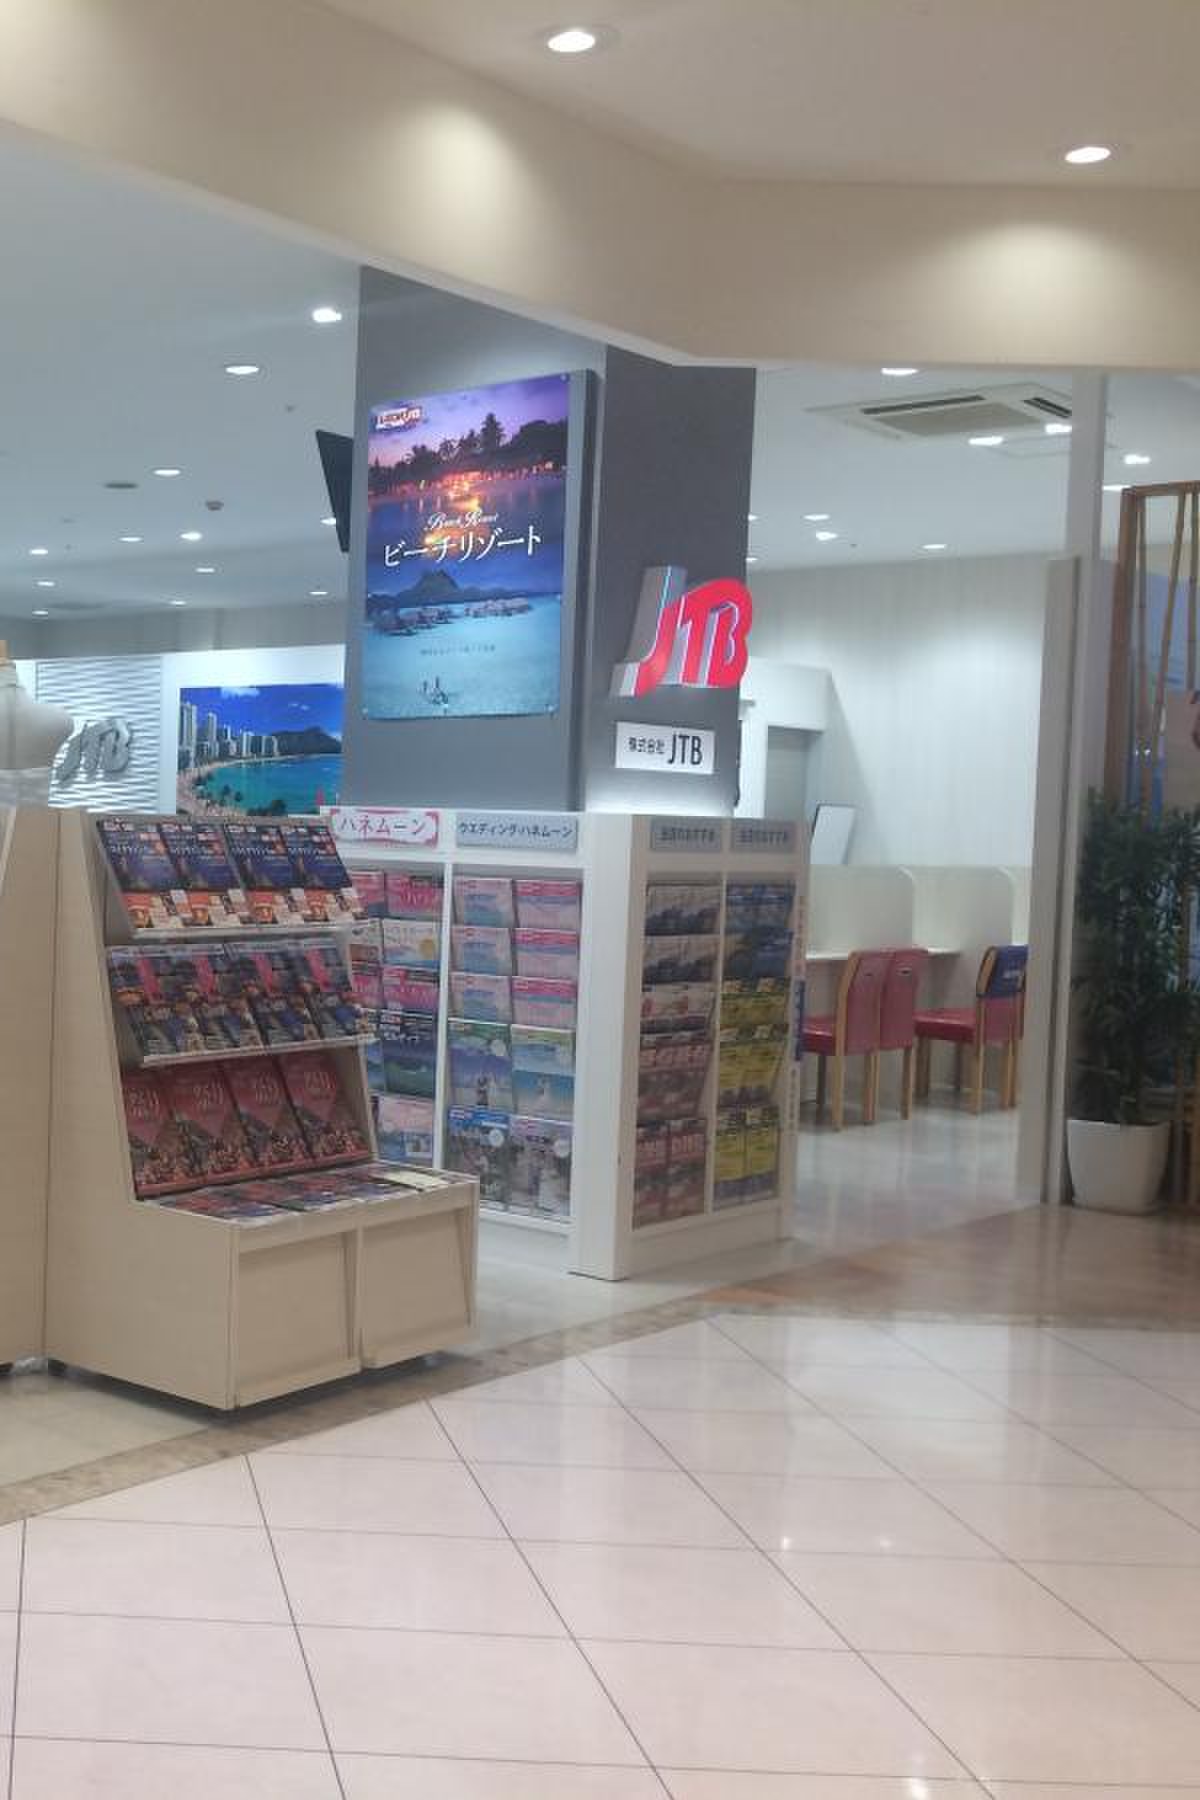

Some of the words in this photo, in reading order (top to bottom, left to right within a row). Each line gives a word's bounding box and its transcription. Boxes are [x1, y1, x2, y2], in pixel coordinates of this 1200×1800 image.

[384, 525, 542, 567] ビーチリゾート
[627, 566, 753, 700] JTB
[628, 736, 666, 755] 株式会社
[667, 732, 704, 766] JTB
[340, 814, 427, 837] ハネムーン
